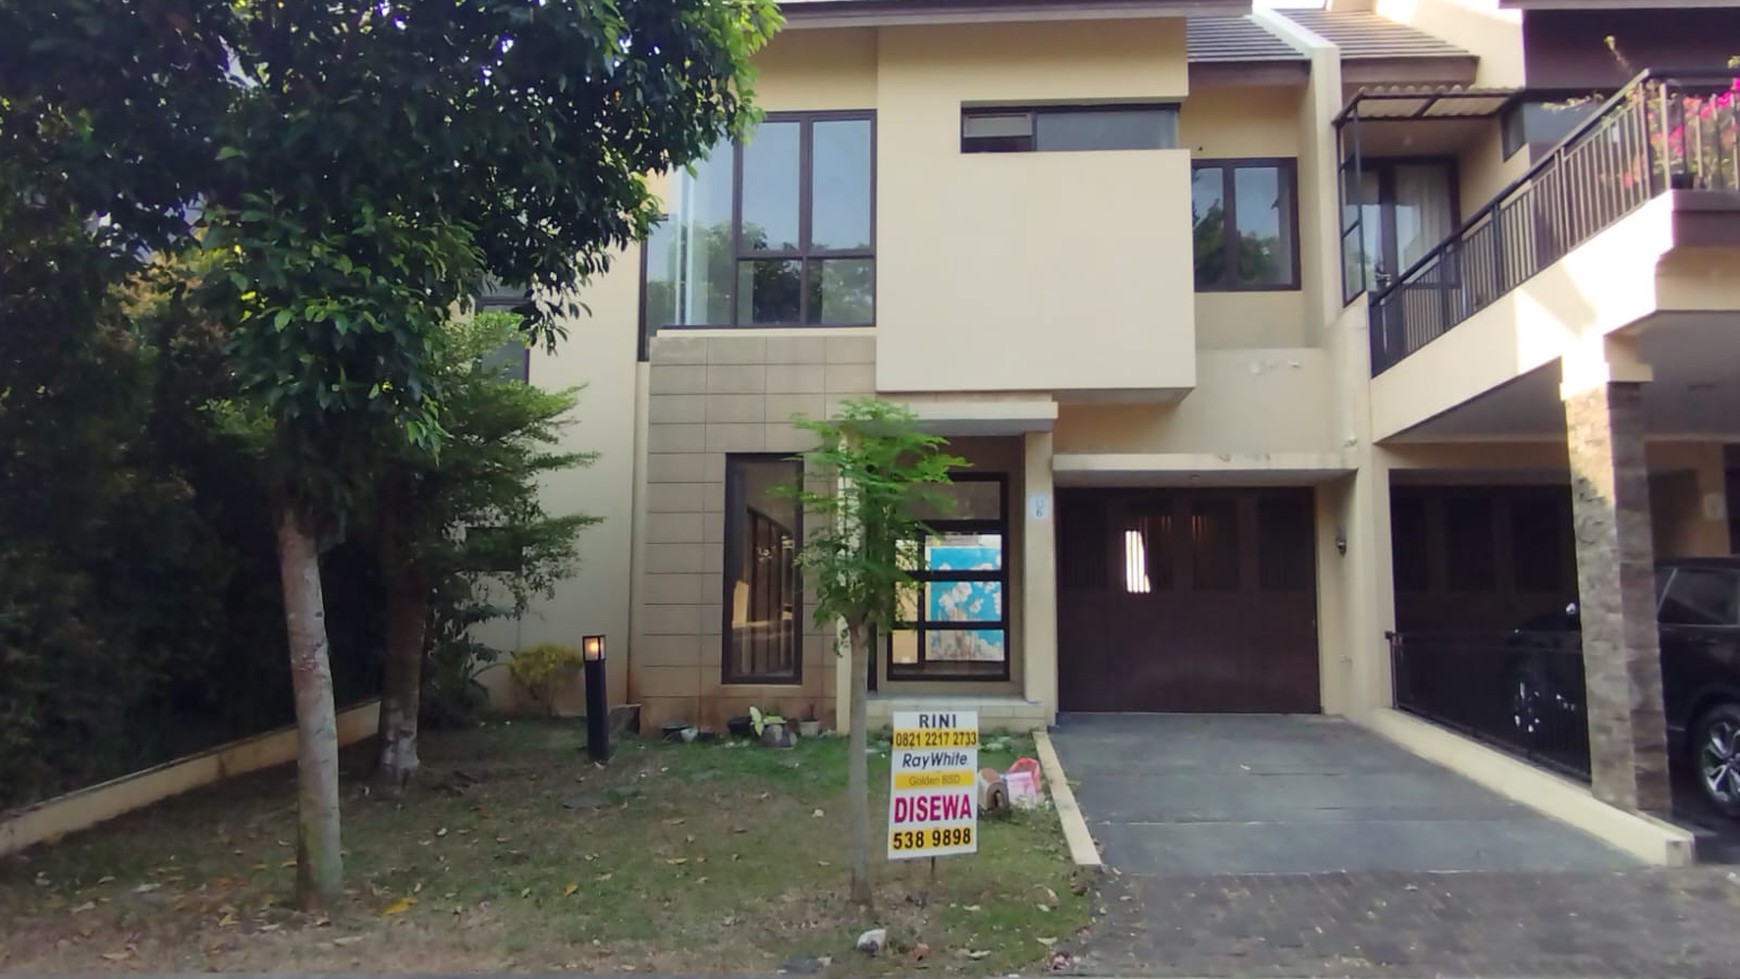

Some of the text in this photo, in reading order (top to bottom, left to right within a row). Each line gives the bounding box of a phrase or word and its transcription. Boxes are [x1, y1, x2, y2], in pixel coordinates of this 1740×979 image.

[918, 713, 957, 729] RINI
[896, 731, 977, 747] 0821 2217 2733
[902, 752, 968, 770] RayWhite
[909, 775, 940, 787] Golden
[893, 793, 972, 824] DISEWA
[893, 827, 971, 850] 538 9898
